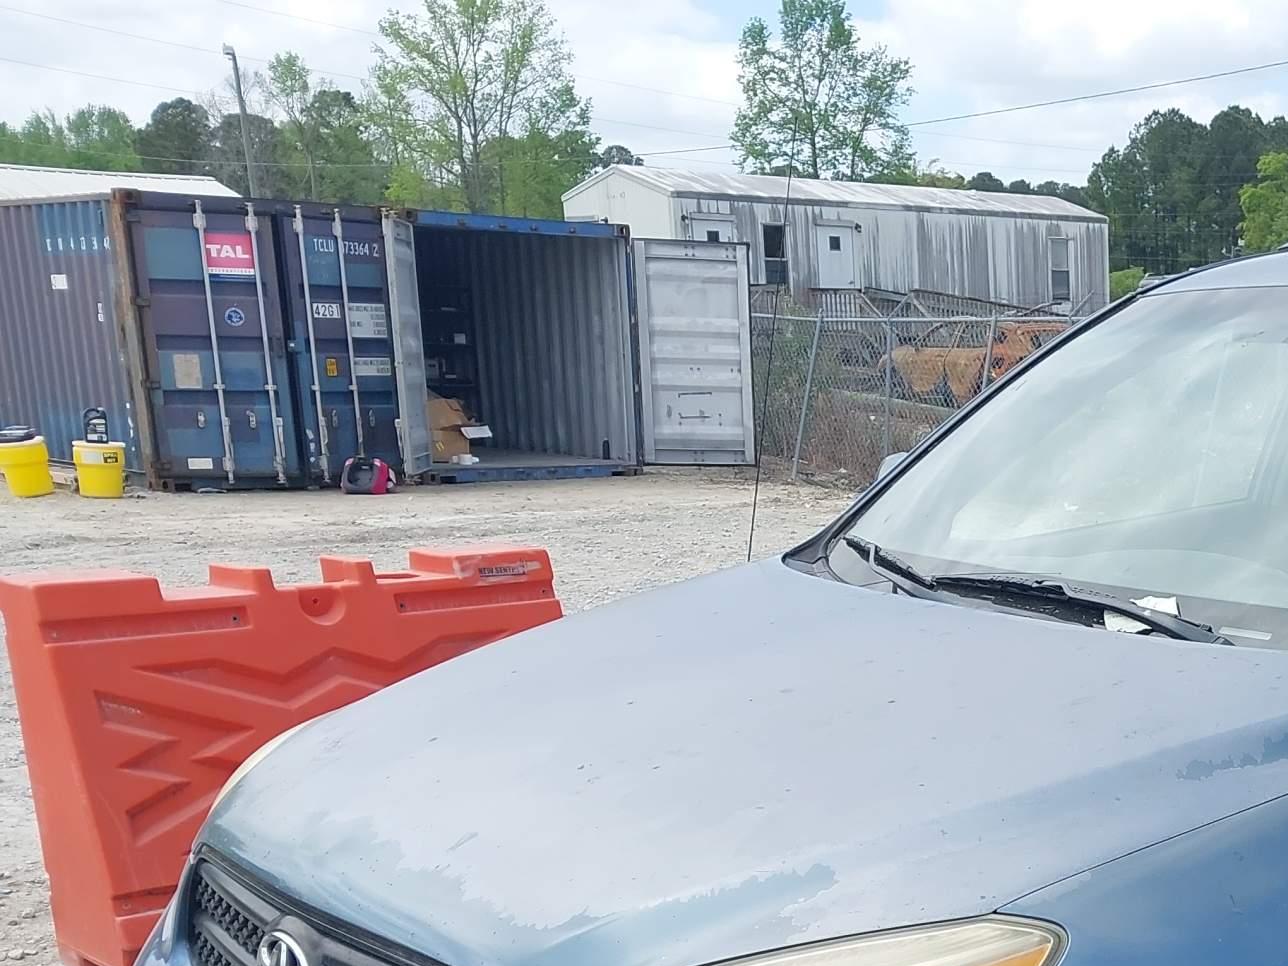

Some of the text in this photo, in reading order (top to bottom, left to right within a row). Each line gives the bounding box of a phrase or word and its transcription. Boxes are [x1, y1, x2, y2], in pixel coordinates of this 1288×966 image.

[206, 244, 249, 258] TAL
[313, 238, 334, 253] TCLU
[314, 304, 340, 317] 42G1
